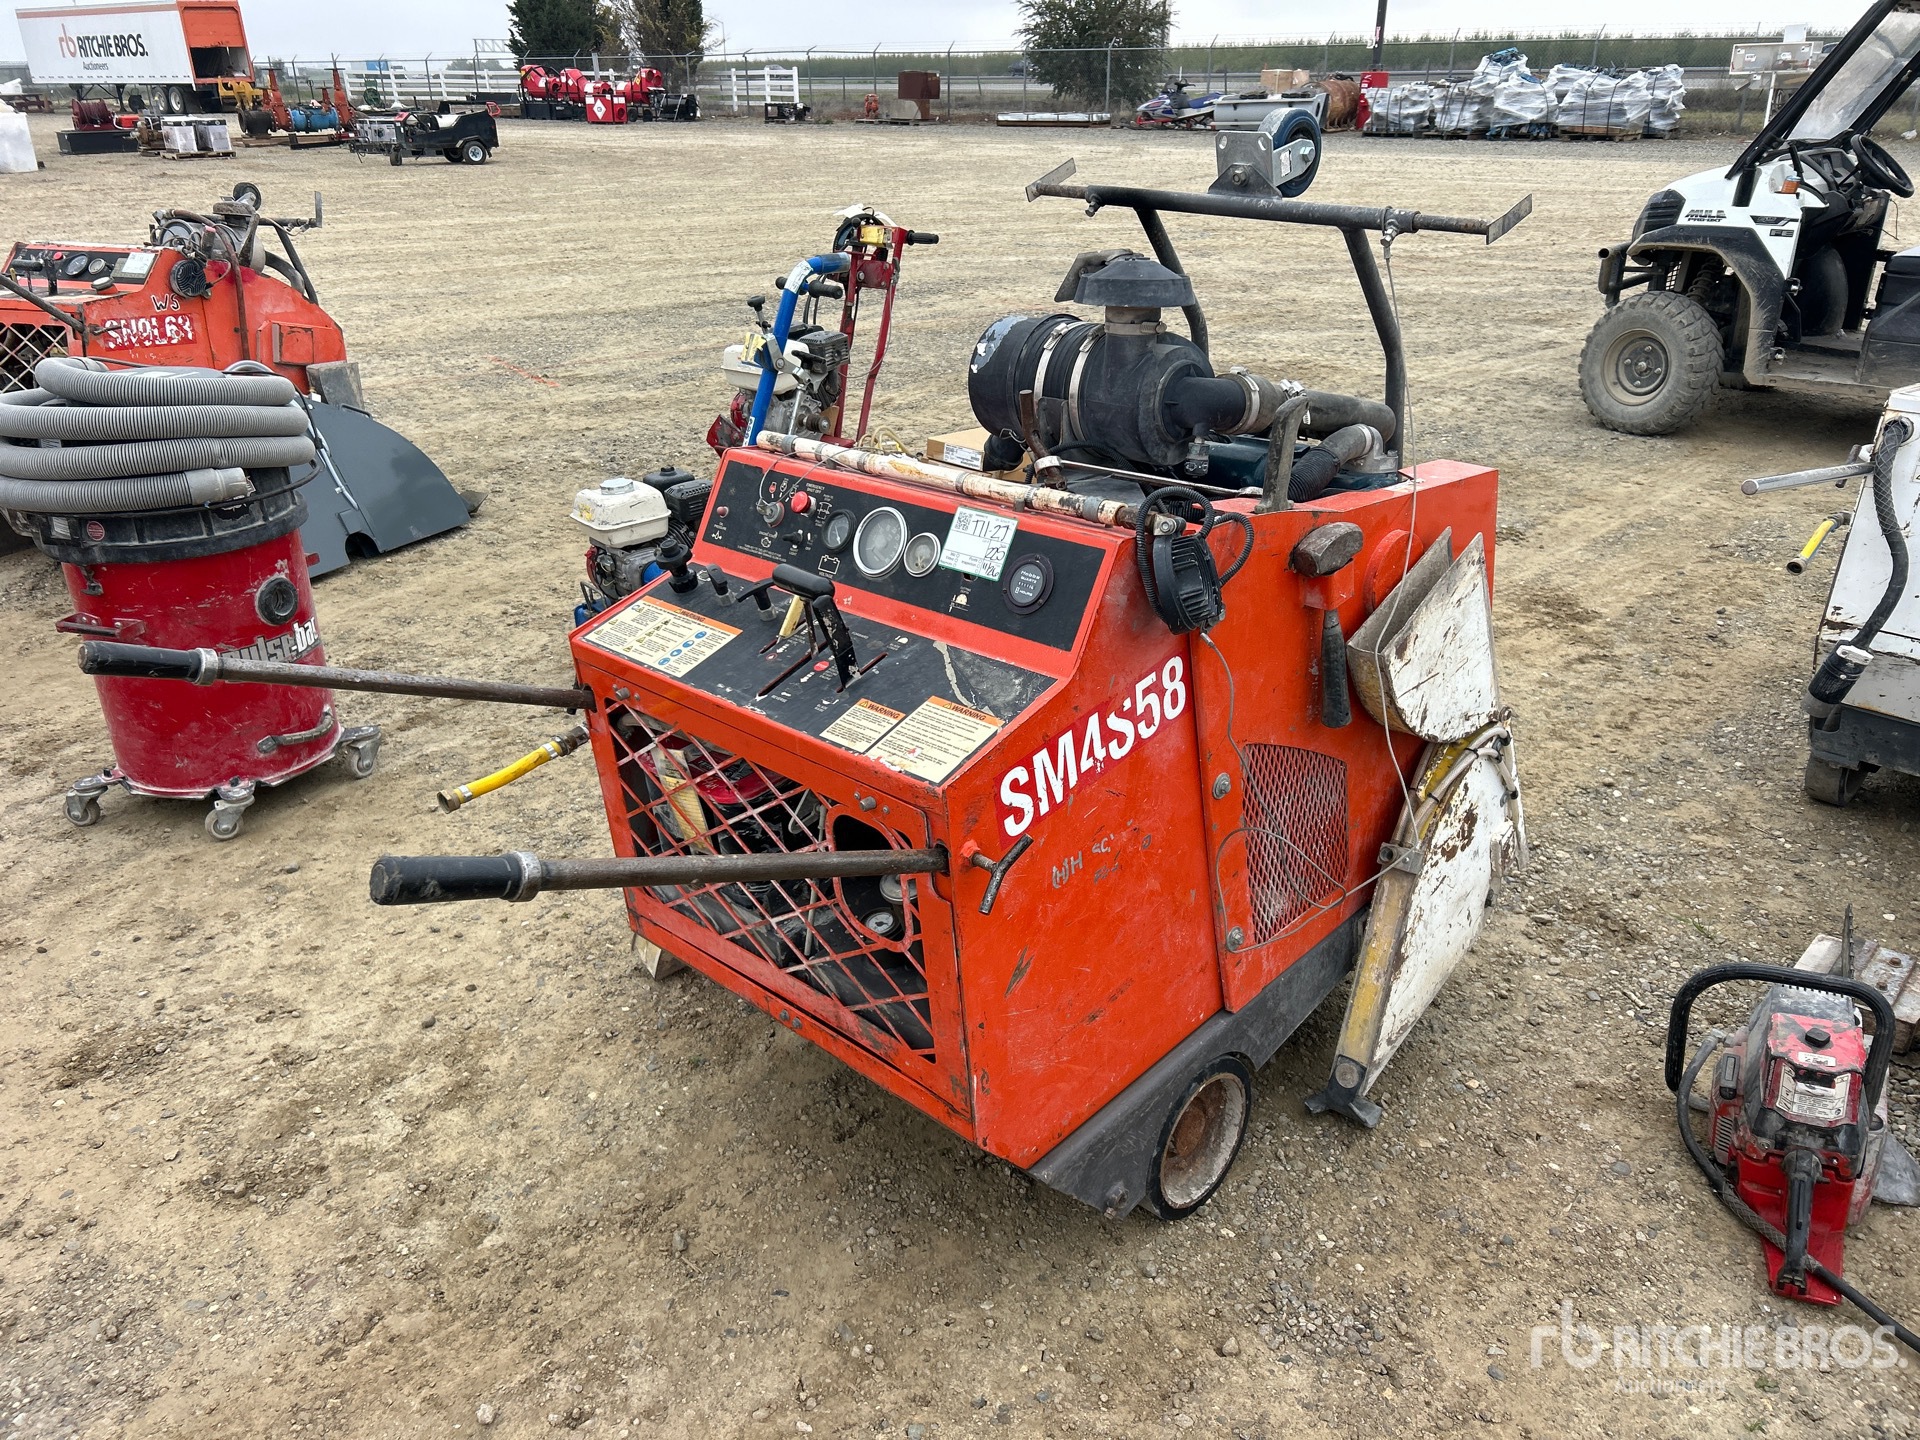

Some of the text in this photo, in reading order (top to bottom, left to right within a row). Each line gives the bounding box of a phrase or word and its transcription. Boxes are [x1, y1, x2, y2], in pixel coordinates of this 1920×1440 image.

[76, 35, 115, 58] RITCHIE
[113, 33, 149, 57] BROS.
[83, 61, 109, 71] Auctioneers
[1685, 209, 1727, 219] MULE
[819, 571, 833, 579] VOLTAGE
[867, 703, 901, 720] WARNING
[951, 705, 987, 721] WARNING
